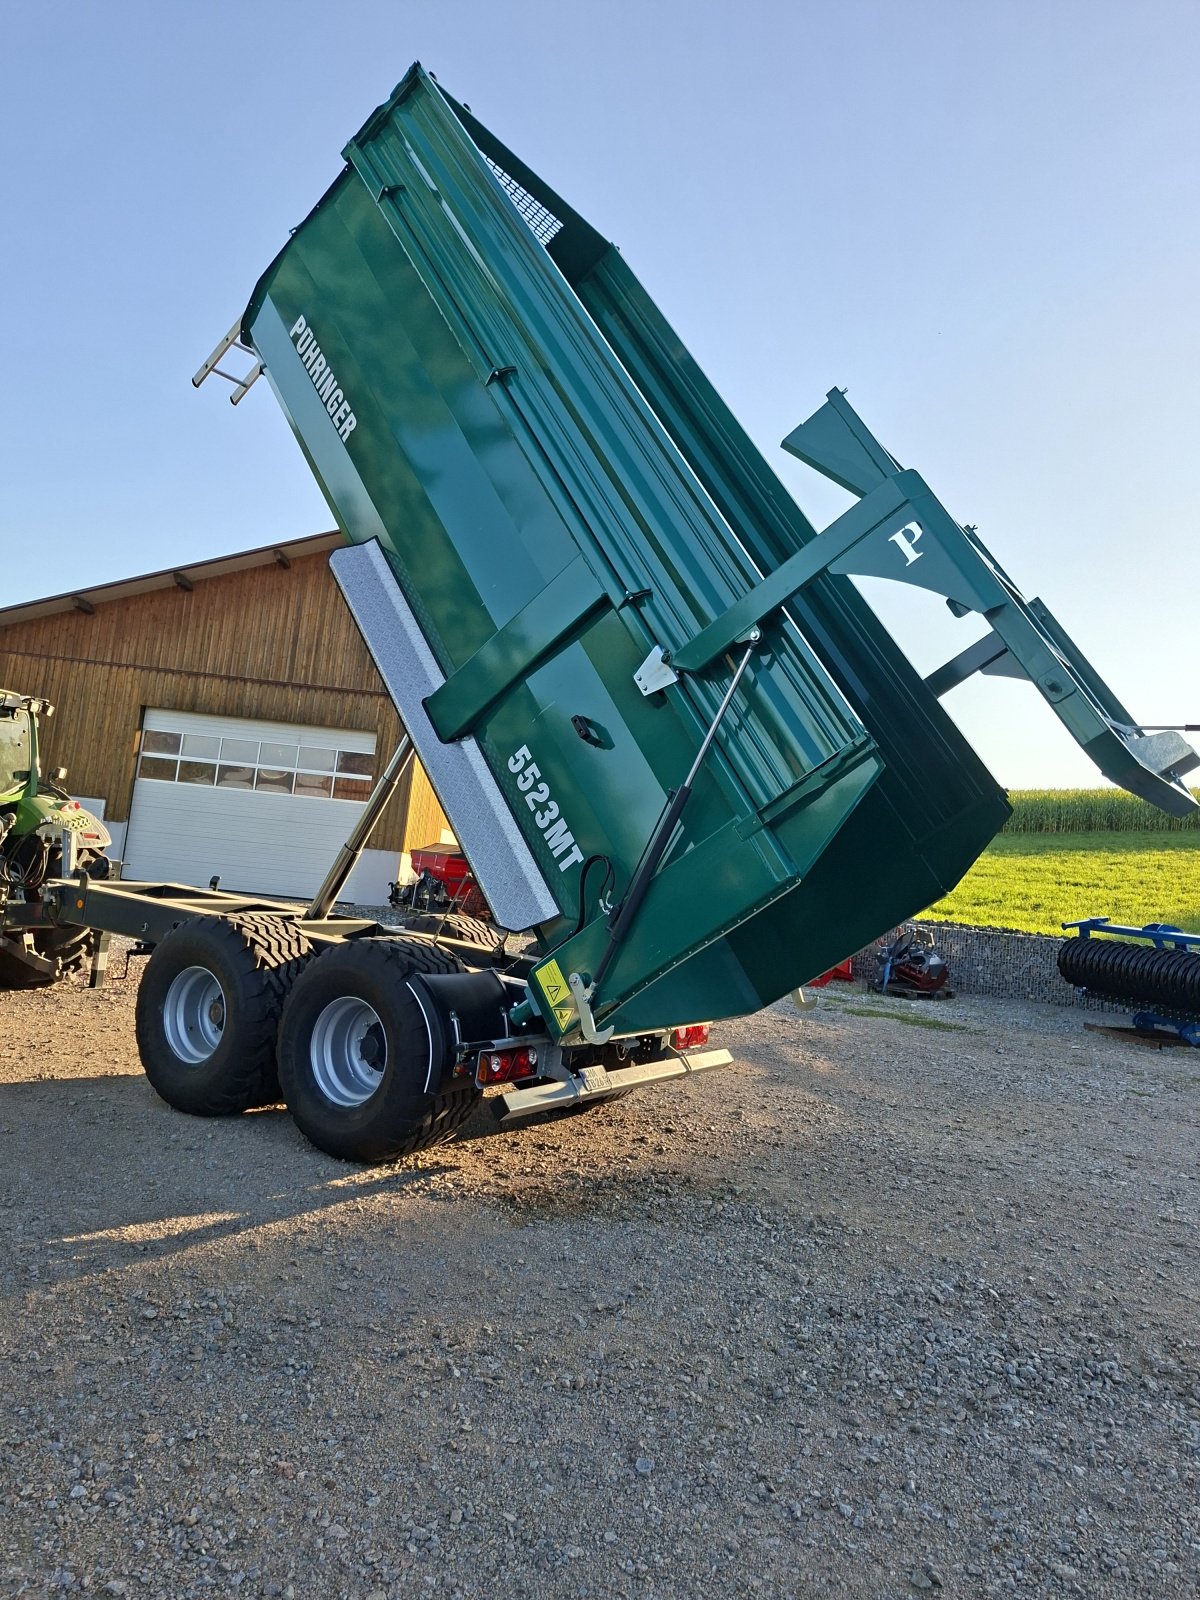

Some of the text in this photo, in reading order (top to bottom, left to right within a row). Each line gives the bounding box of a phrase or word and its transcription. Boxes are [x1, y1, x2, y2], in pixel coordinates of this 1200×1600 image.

[290, 315, 357, 443] PÜHRINGER
[888, 521, 924, 567] P
[507, 744, 584, 872] 5523MT
